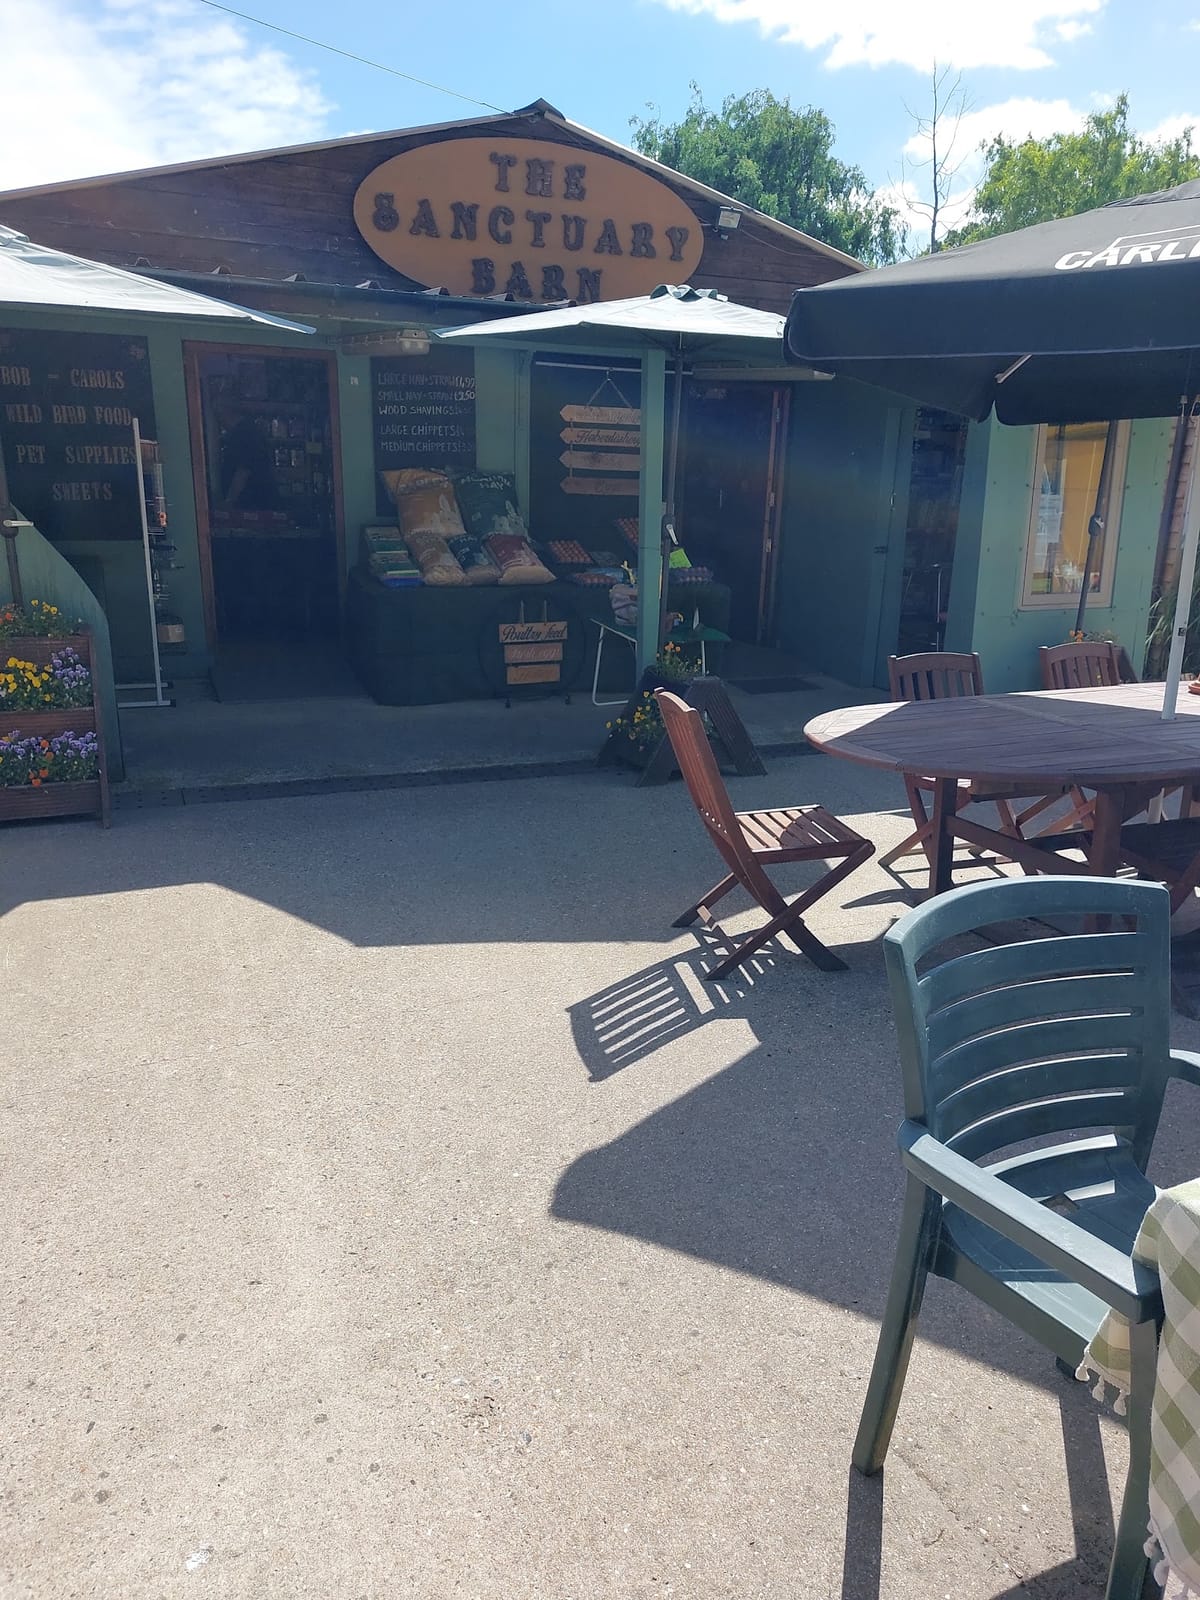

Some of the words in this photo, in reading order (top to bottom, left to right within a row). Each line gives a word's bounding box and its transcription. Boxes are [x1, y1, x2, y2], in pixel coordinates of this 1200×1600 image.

[490, 151, 587, 201] THE
[372, 192, 689, 262] SANCTUARY
[471, 257, 603, 303] BARN
[71, 368, 125, 389] CAROLS
[6, 404, 42, 423] WILD
[52, 405, 86, 424] BIRD
[94, 406, 132, 426] FOOD
[379, 405, 406, 415] WOOD
[410, 406, 454, 415] SHAVINGS
[380, 425, 408, 436] LARGE
[16, 445, 46, 464] PET
[65, 446, 136, 465] SUPPLIES
[52, 481, 112, 501] SWEETS
[503, 625, 541, 641] Poultry
